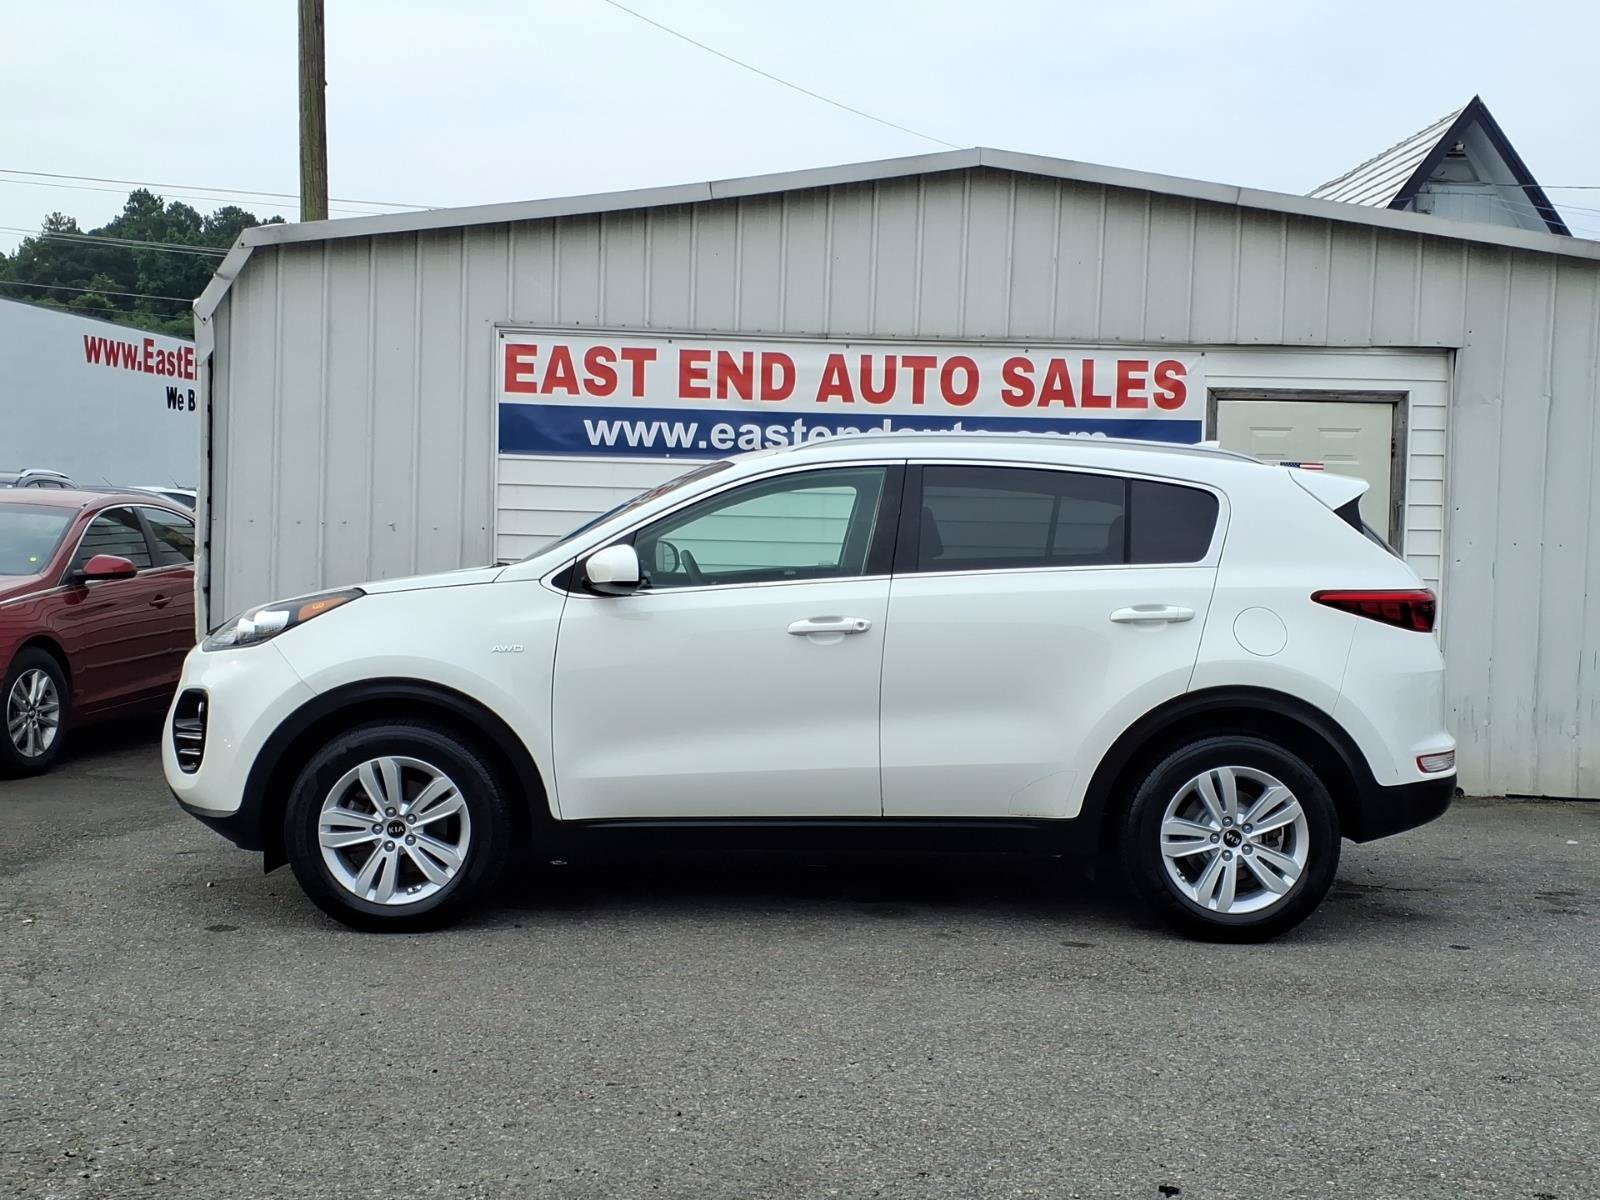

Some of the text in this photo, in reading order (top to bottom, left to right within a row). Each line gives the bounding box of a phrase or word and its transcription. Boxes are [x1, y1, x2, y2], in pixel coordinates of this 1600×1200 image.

[503, 343, 1188, 410] EAST END AUTO SALES
[166, 386, 184, 411] We
[491, 644, 525, 654] AWD
